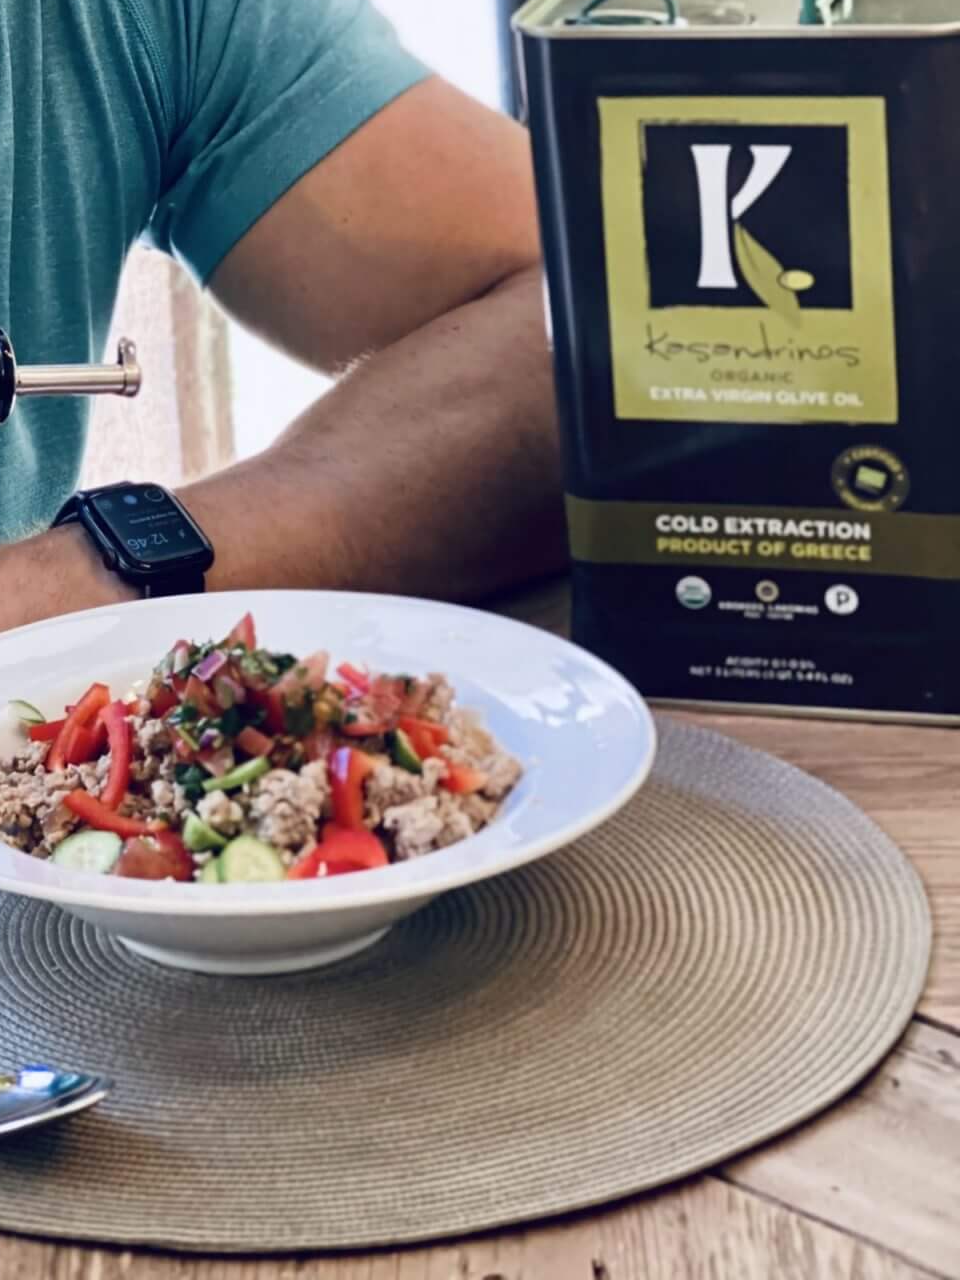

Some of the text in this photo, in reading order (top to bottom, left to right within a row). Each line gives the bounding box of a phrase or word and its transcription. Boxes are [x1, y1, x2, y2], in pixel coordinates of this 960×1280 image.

[690, 144, 797, 300] K
[644, 322, 860, 368] Kasandrinos
[711, 369, 793, 384] ORGANIC
[650, 386, 864, 407] EXTRA VIRGIN OLIVE OIL
[656, 514, 872, 540] COLD EXTRACTION
[656, 537, 872, 561] PRODUCT OF GREECE
[836, 591, 850, 607] P
